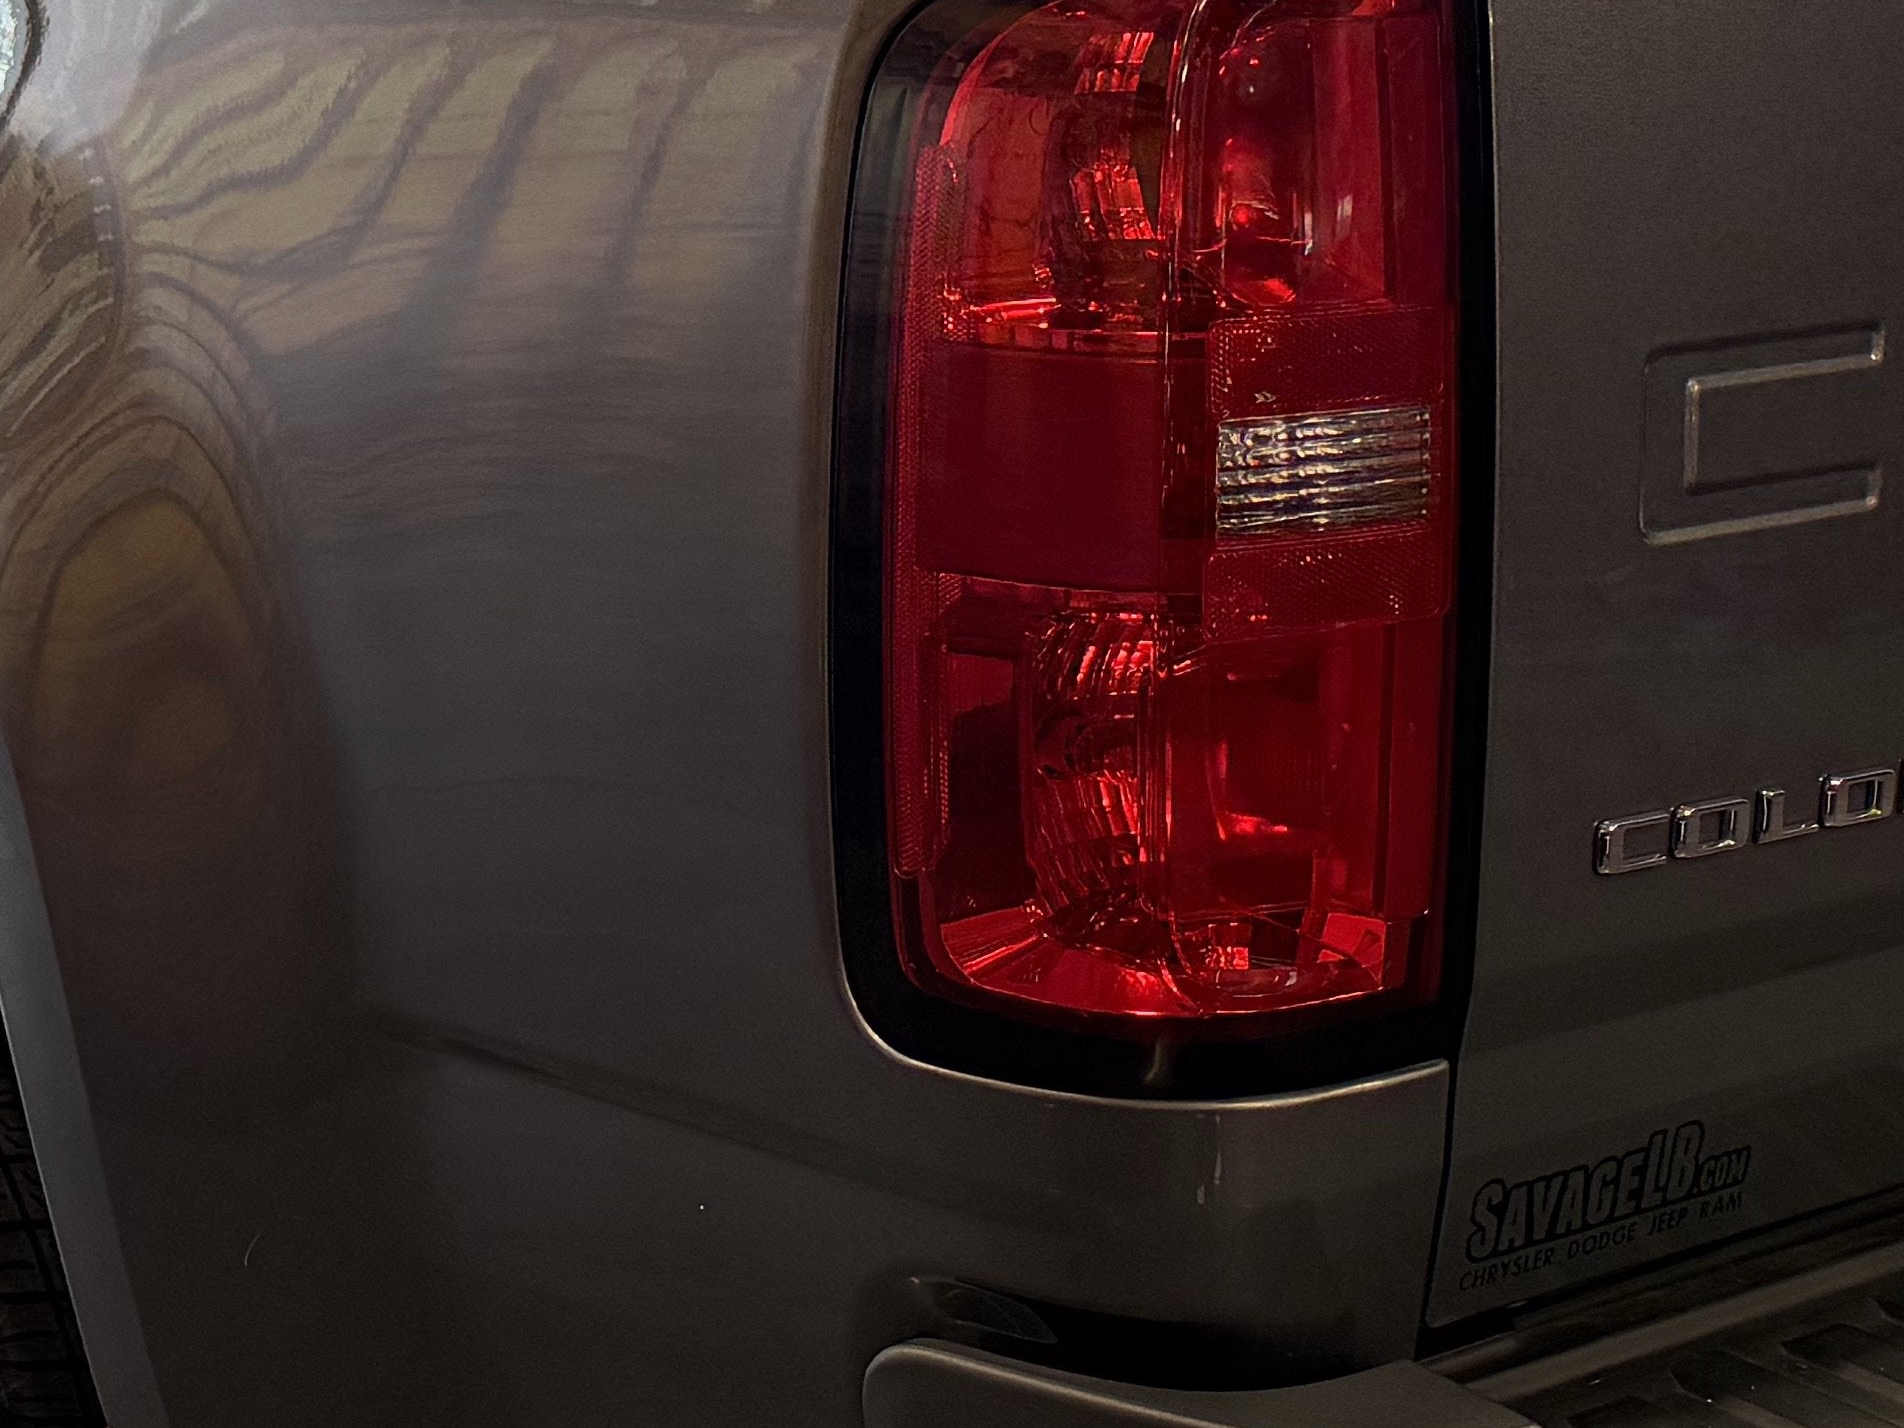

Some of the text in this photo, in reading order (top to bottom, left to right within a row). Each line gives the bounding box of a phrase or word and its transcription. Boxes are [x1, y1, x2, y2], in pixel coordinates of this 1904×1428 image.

[1458, 1191, 1744, 1292] CHRYSLER DODGE JEEP RAM
